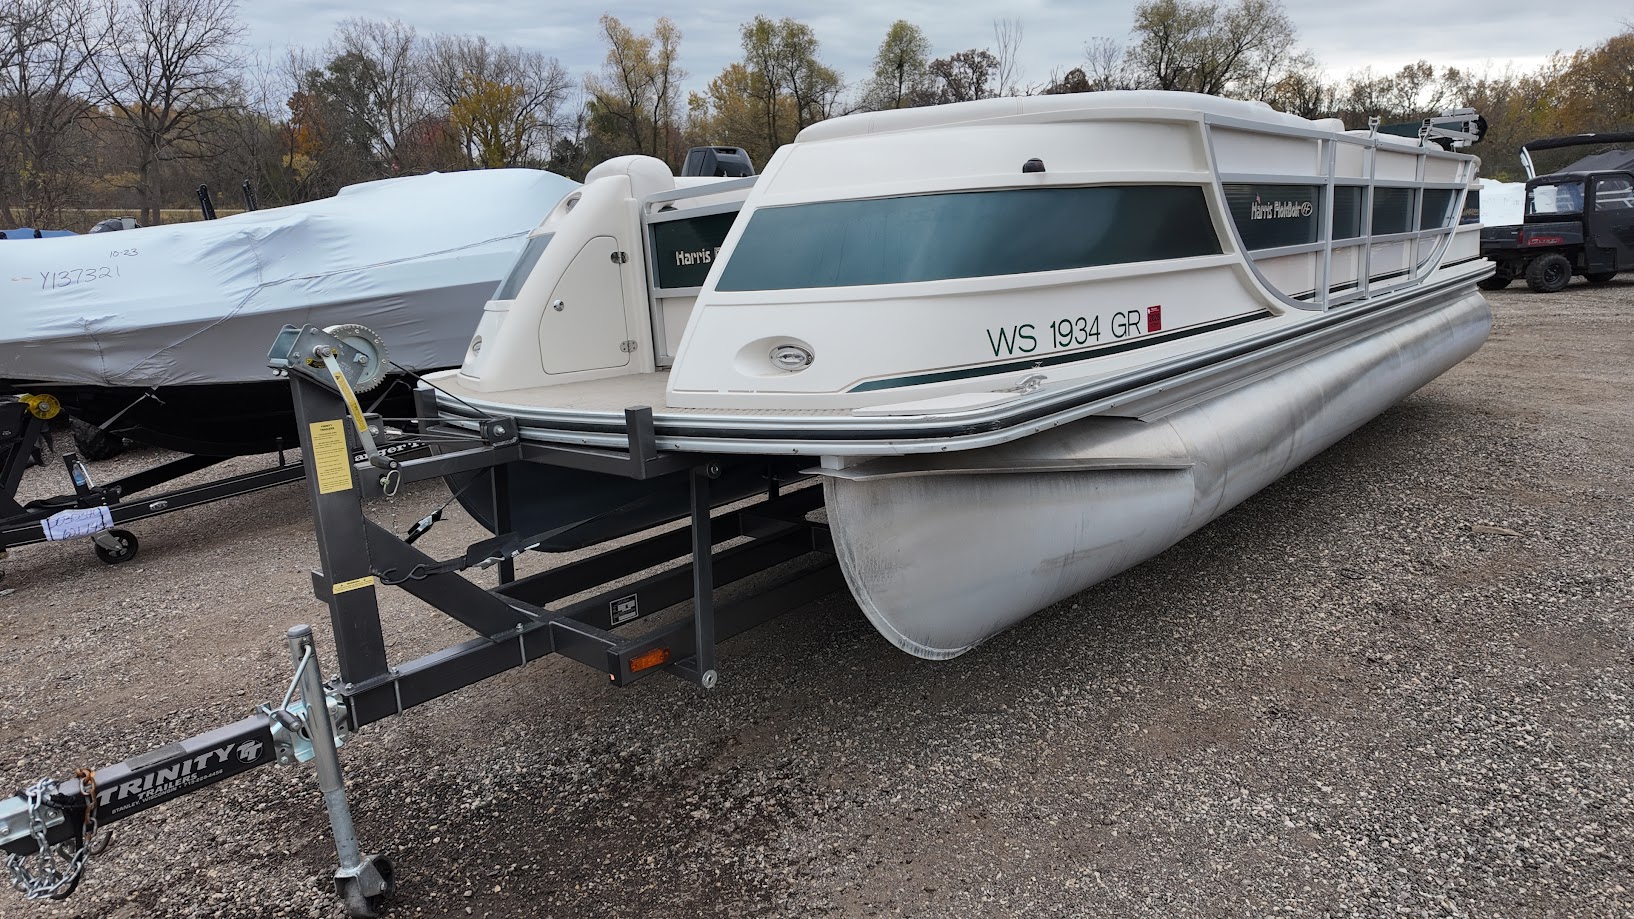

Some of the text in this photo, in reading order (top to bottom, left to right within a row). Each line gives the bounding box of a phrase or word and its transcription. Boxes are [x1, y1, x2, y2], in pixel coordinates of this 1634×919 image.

[1251, 202, 1273, 220] Harris
[675, 248, 711, 266] Harris
[39, 266, 120, 290] Y137321
[986, 310, 1141, 357] WS 1934 GR
[97, 743, 235, 807] TRINITY
[137, 773, 198, 800] TRAILERS
